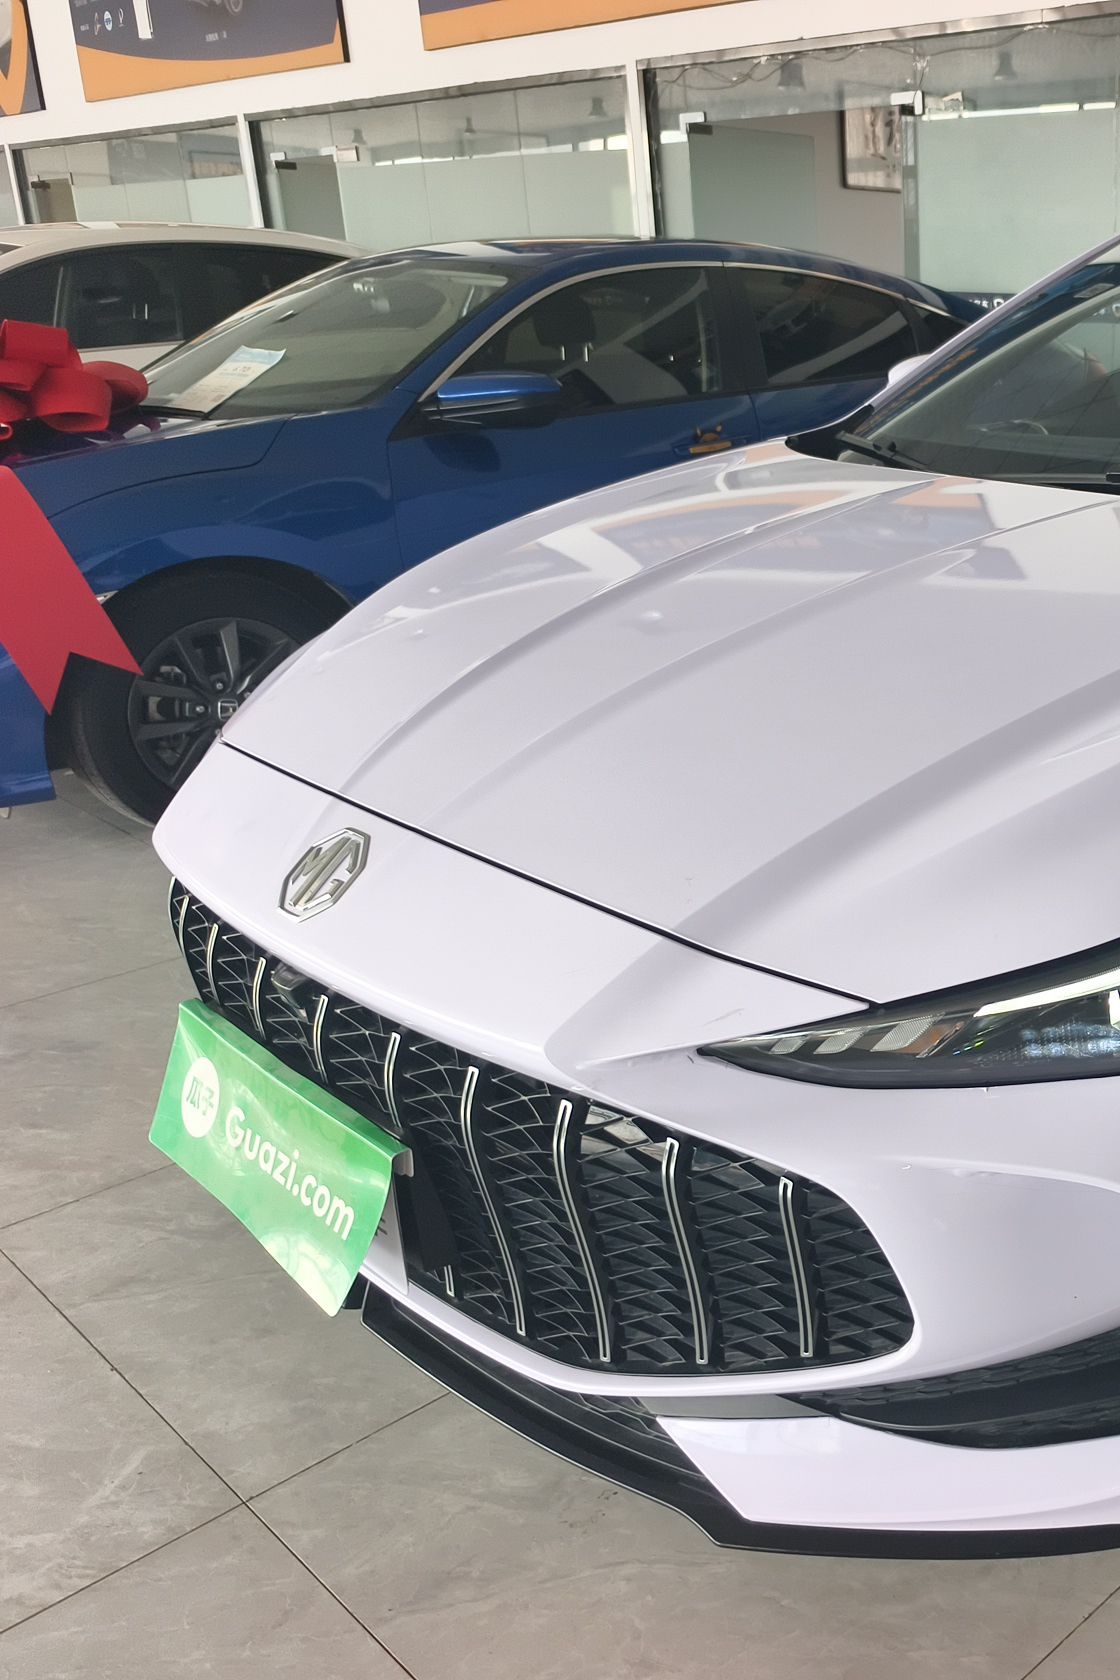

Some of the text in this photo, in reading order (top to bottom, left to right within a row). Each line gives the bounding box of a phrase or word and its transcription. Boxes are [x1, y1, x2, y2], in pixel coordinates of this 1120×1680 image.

[288, 833, 363, 913] MG
[186, 1075, 214, 1116] 瓜子
[225, 1106, 355, 1241] Guazi.com
